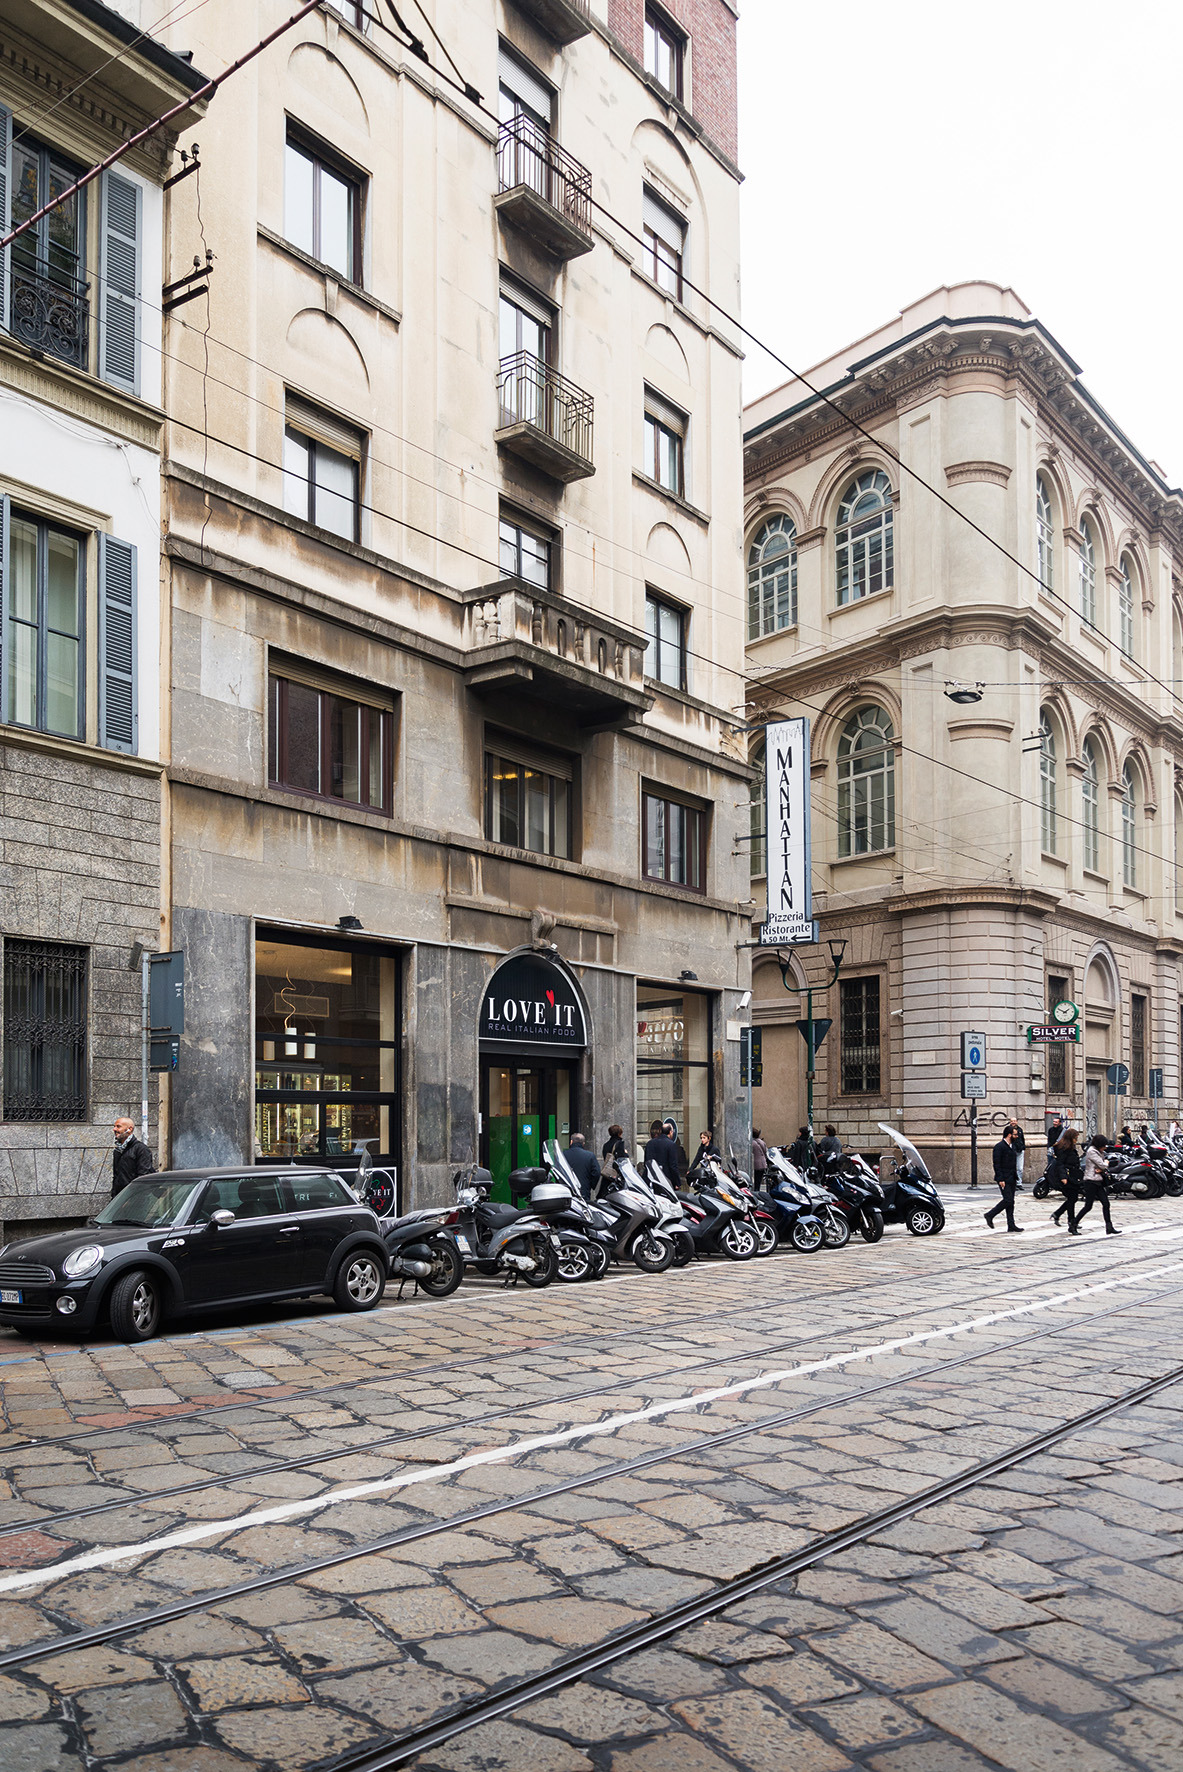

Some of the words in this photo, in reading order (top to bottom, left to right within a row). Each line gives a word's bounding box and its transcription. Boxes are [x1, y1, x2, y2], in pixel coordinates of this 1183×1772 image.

[777, 745, 793, 911] MANHATTAN
[768, 911, 803, 923] Pizzeria
[762, 923, 810, 935] Ristorante
[488, 1022, 512, 1032] REAL
[515, 1024, 550, 1034] ITALIAN
[552, 1028, 576, 1037] FOOD
[1032, 1027, 1076, 1036] SILVER
